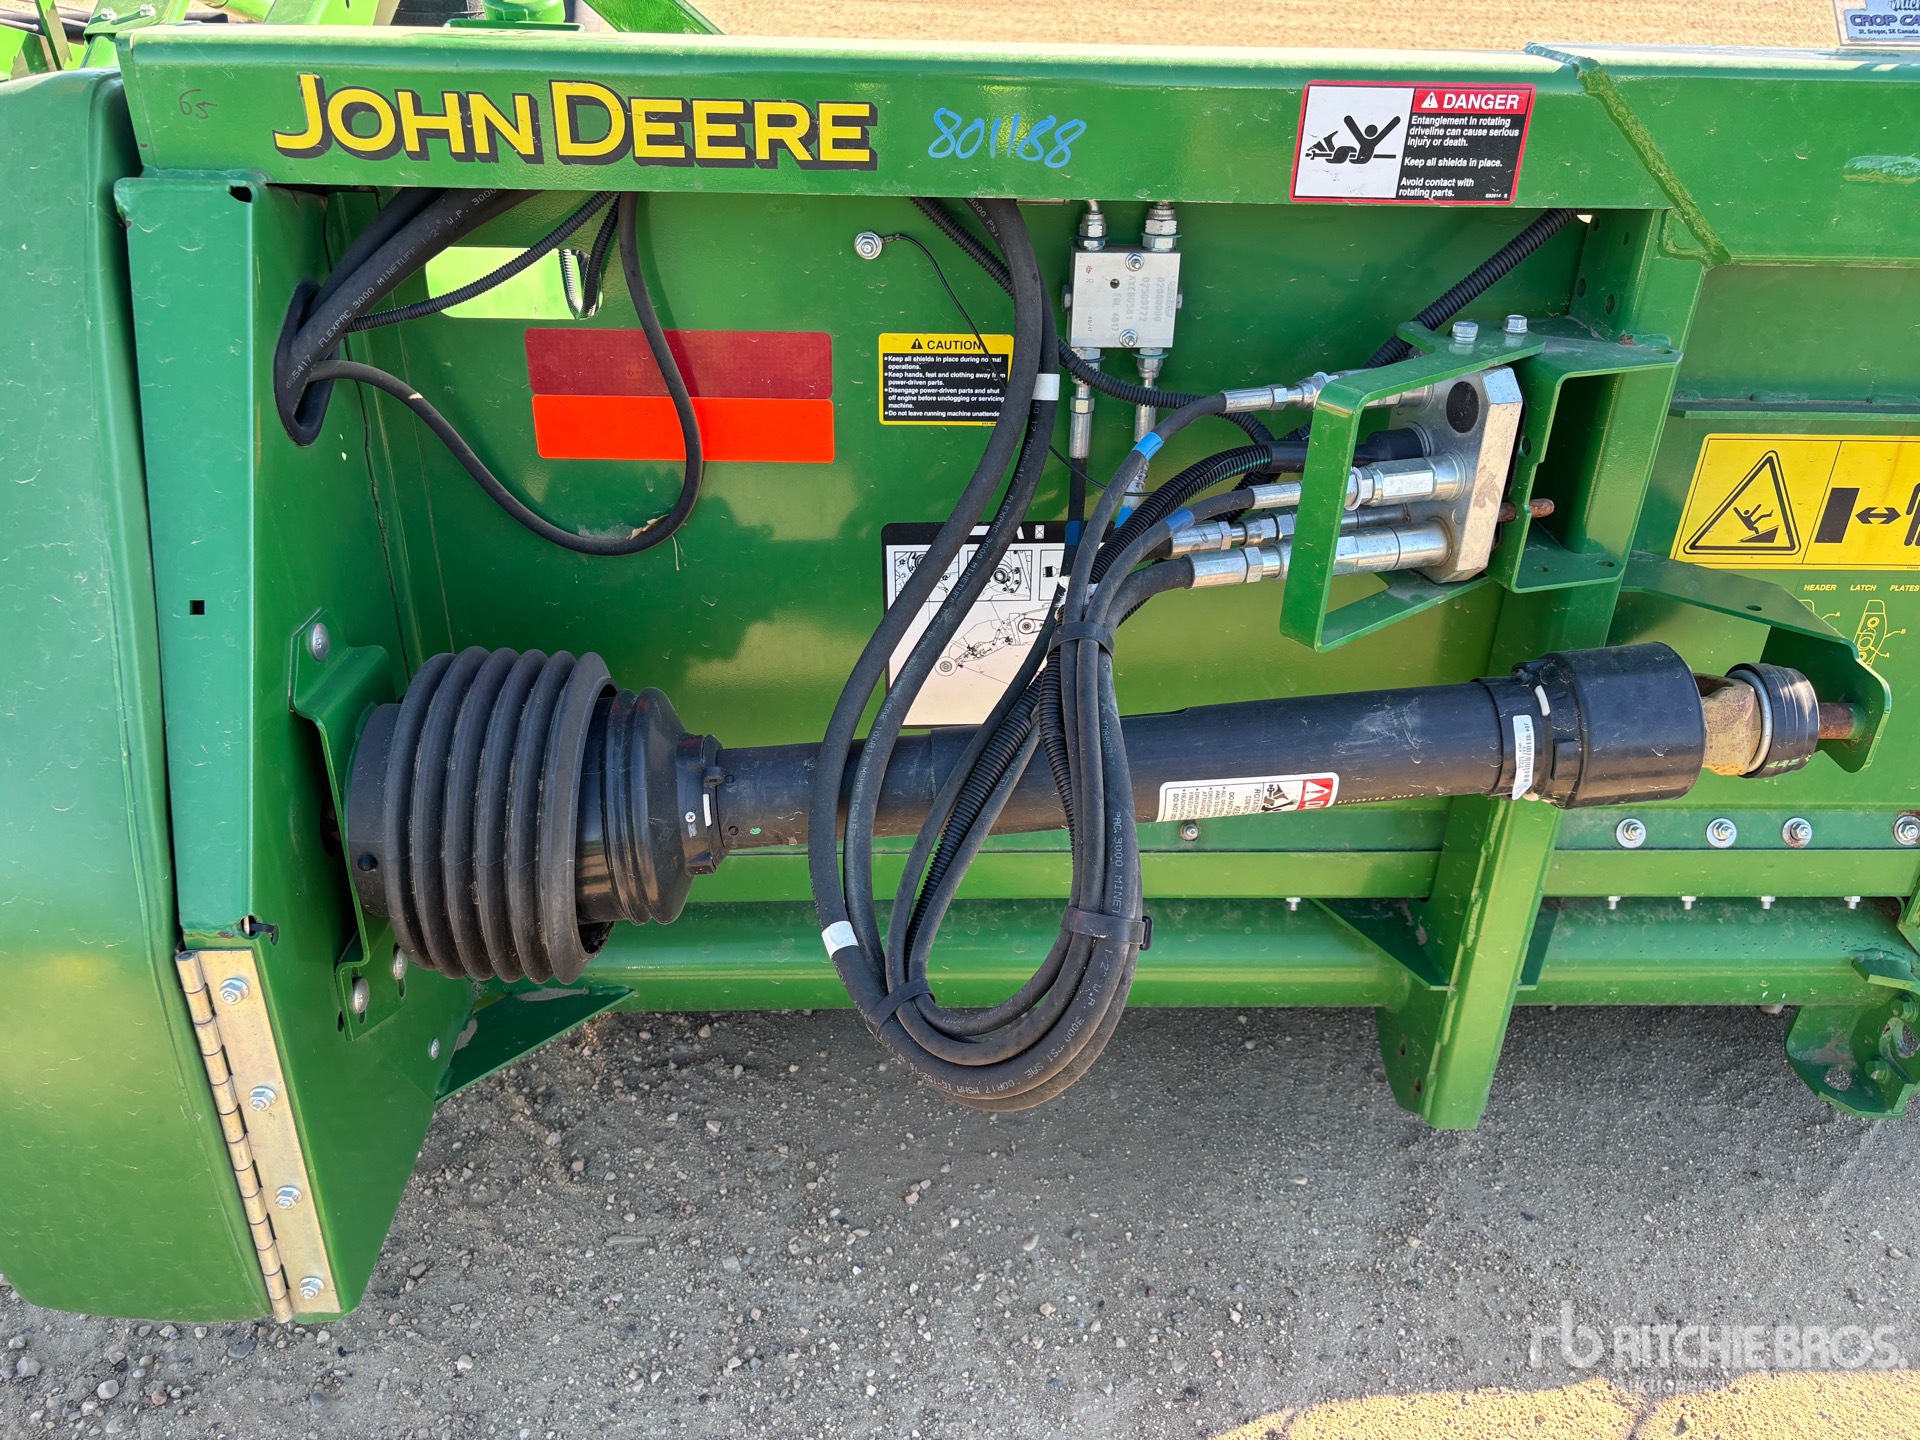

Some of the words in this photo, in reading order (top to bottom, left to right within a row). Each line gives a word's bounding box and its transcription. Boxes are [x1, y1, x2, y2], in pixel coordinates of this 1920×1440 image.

[1850, 14, 1898, 26] CROP
[1442, 94, 1520, 110] DANGER
[272, 72, 544, 164] JOHN
[549, 80, 878, 171] DEERE
[1411, 116, 1467, 127] Entanglement
[1469, 116, 1477, 126] in
[1478, 117, 1511, 128] rotating
[1409, 126, 1445, 137] driveline
[1446, 128, 1461, 136] can
[1463, 128, 1487, 137] cause
[1488, 127, 1519, 137] serious
[928, 107, 1087, 169] 801188
[1407, 137, 1431, 148] injury
[1432, 139, 1442, 147] or
[1443, 137, 1469, 147] death.
[1404, 157, 1425, 168] Keep
[1426, 158, 1437, 167] all
[1438, 157, 1467, 168] shields
[1469, 158, 1478, 168] in
[1478, 158, 1503, 169] place.
[1400, 177, 1424, 187] Avoid
[1425, 178, 1456, 188] contact
[1457, 178, 1475, 187] with
[1399, 188, 1430, 198] rotating
[1431, 188, 1455, 199] parts.
[317, 309, 352, 348] FLEXPAC
[353, 287, 375, 311] 3000
[376, 245, 417, 287] MINETUFF
[927, 340, 982, 350] CAUTION
[960, 356, 979, 364] during
[950, 371, 974, 379] clothing
[888, 387, 918, 395] Disengage
[920, 387, 957, 395] power-driven
[937, 395, 970, 403] unclogging
[978, 395, 1005, 403] servicing
[1803, 584, 1837, 592] HEADER
[1850, 584, 1876, 592] LATCH
[1889, 584, 1920, 592] PLATES
[1113, 836, 1124, 867] 3000
[1063, 1016, 1085, 1044] 3000
